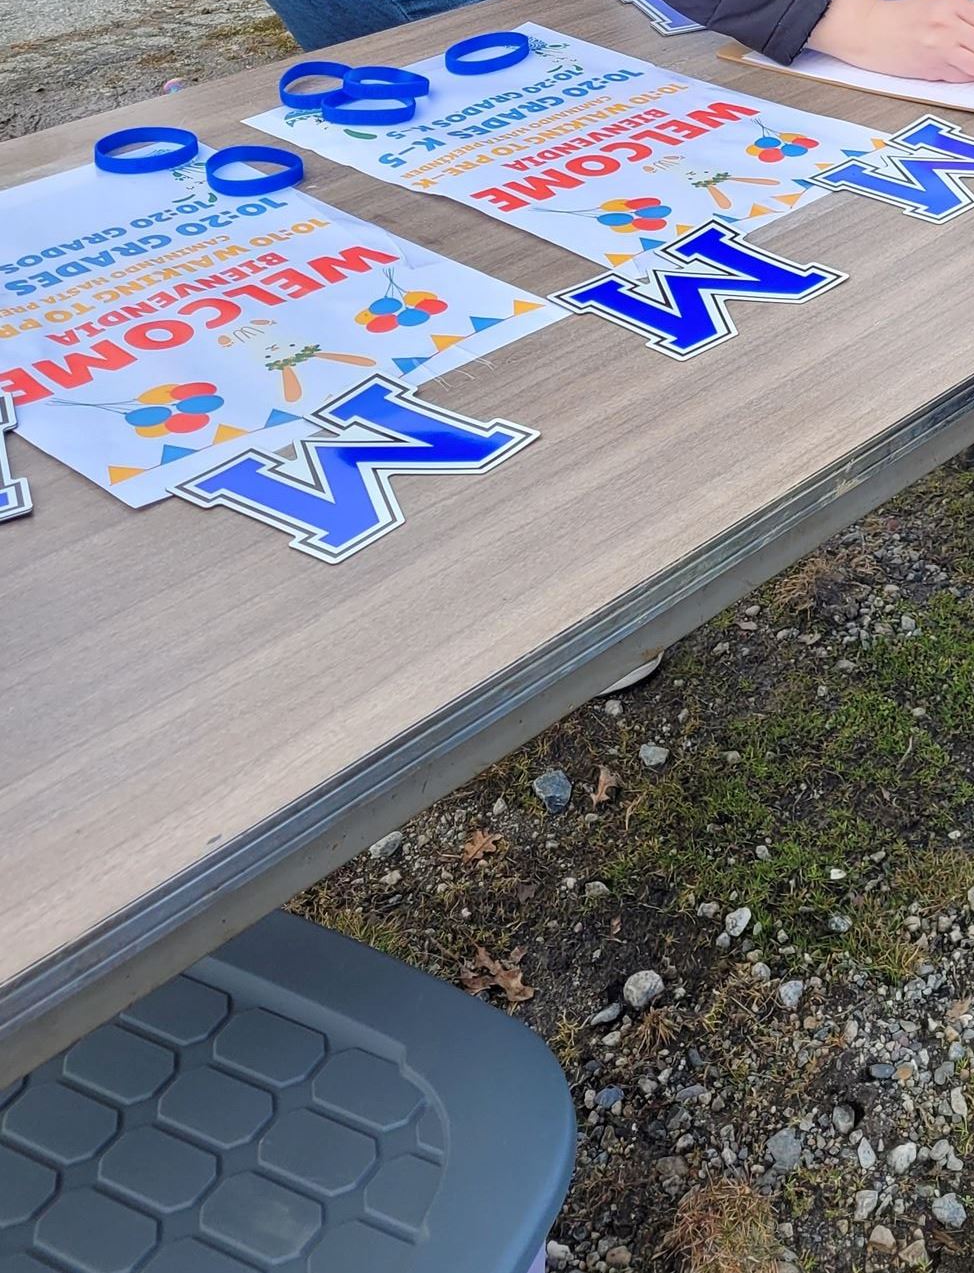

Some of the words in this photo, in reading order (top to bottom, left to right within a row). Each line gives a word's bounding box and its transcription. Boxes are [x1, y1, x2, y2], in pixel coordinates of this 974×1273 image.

[522, 67, 584, 94] 10:20
[562, 68, 645, 97] 10:20
[628, 83, 689, 104] 10:10
[432, 91, 523, 128] GRADOS
[447, 95, 565, 139] GRADES
[525, 103, 632, 145] WALKING
[529, 95, 613, 129] CAMINANDO
[378, 136, 447, 168] K-5
[469, 101, 761, 213] WELCOME
[491, 142, 530, 156] TO
[501, 108, 671, 172] BIENVENDIA
[130, 200, 214, 228] 10:20
[175, 197, 289, 236] 10:20
[248, 218, 331, 246] 10:10
[0, 227, 127, 274] GRADOS
[4, 234, 173, 296] GRADES
[110, 235, 231, 278] CAMINANDO
[40, 277, 109, 305] HASTA
[91, 244, 251, 303] WALKING
[44, 302, 96, 323] TO
[45, 251, 289, 346] BIENVENDIA
[0, 246, 400, 406] WELCOME
